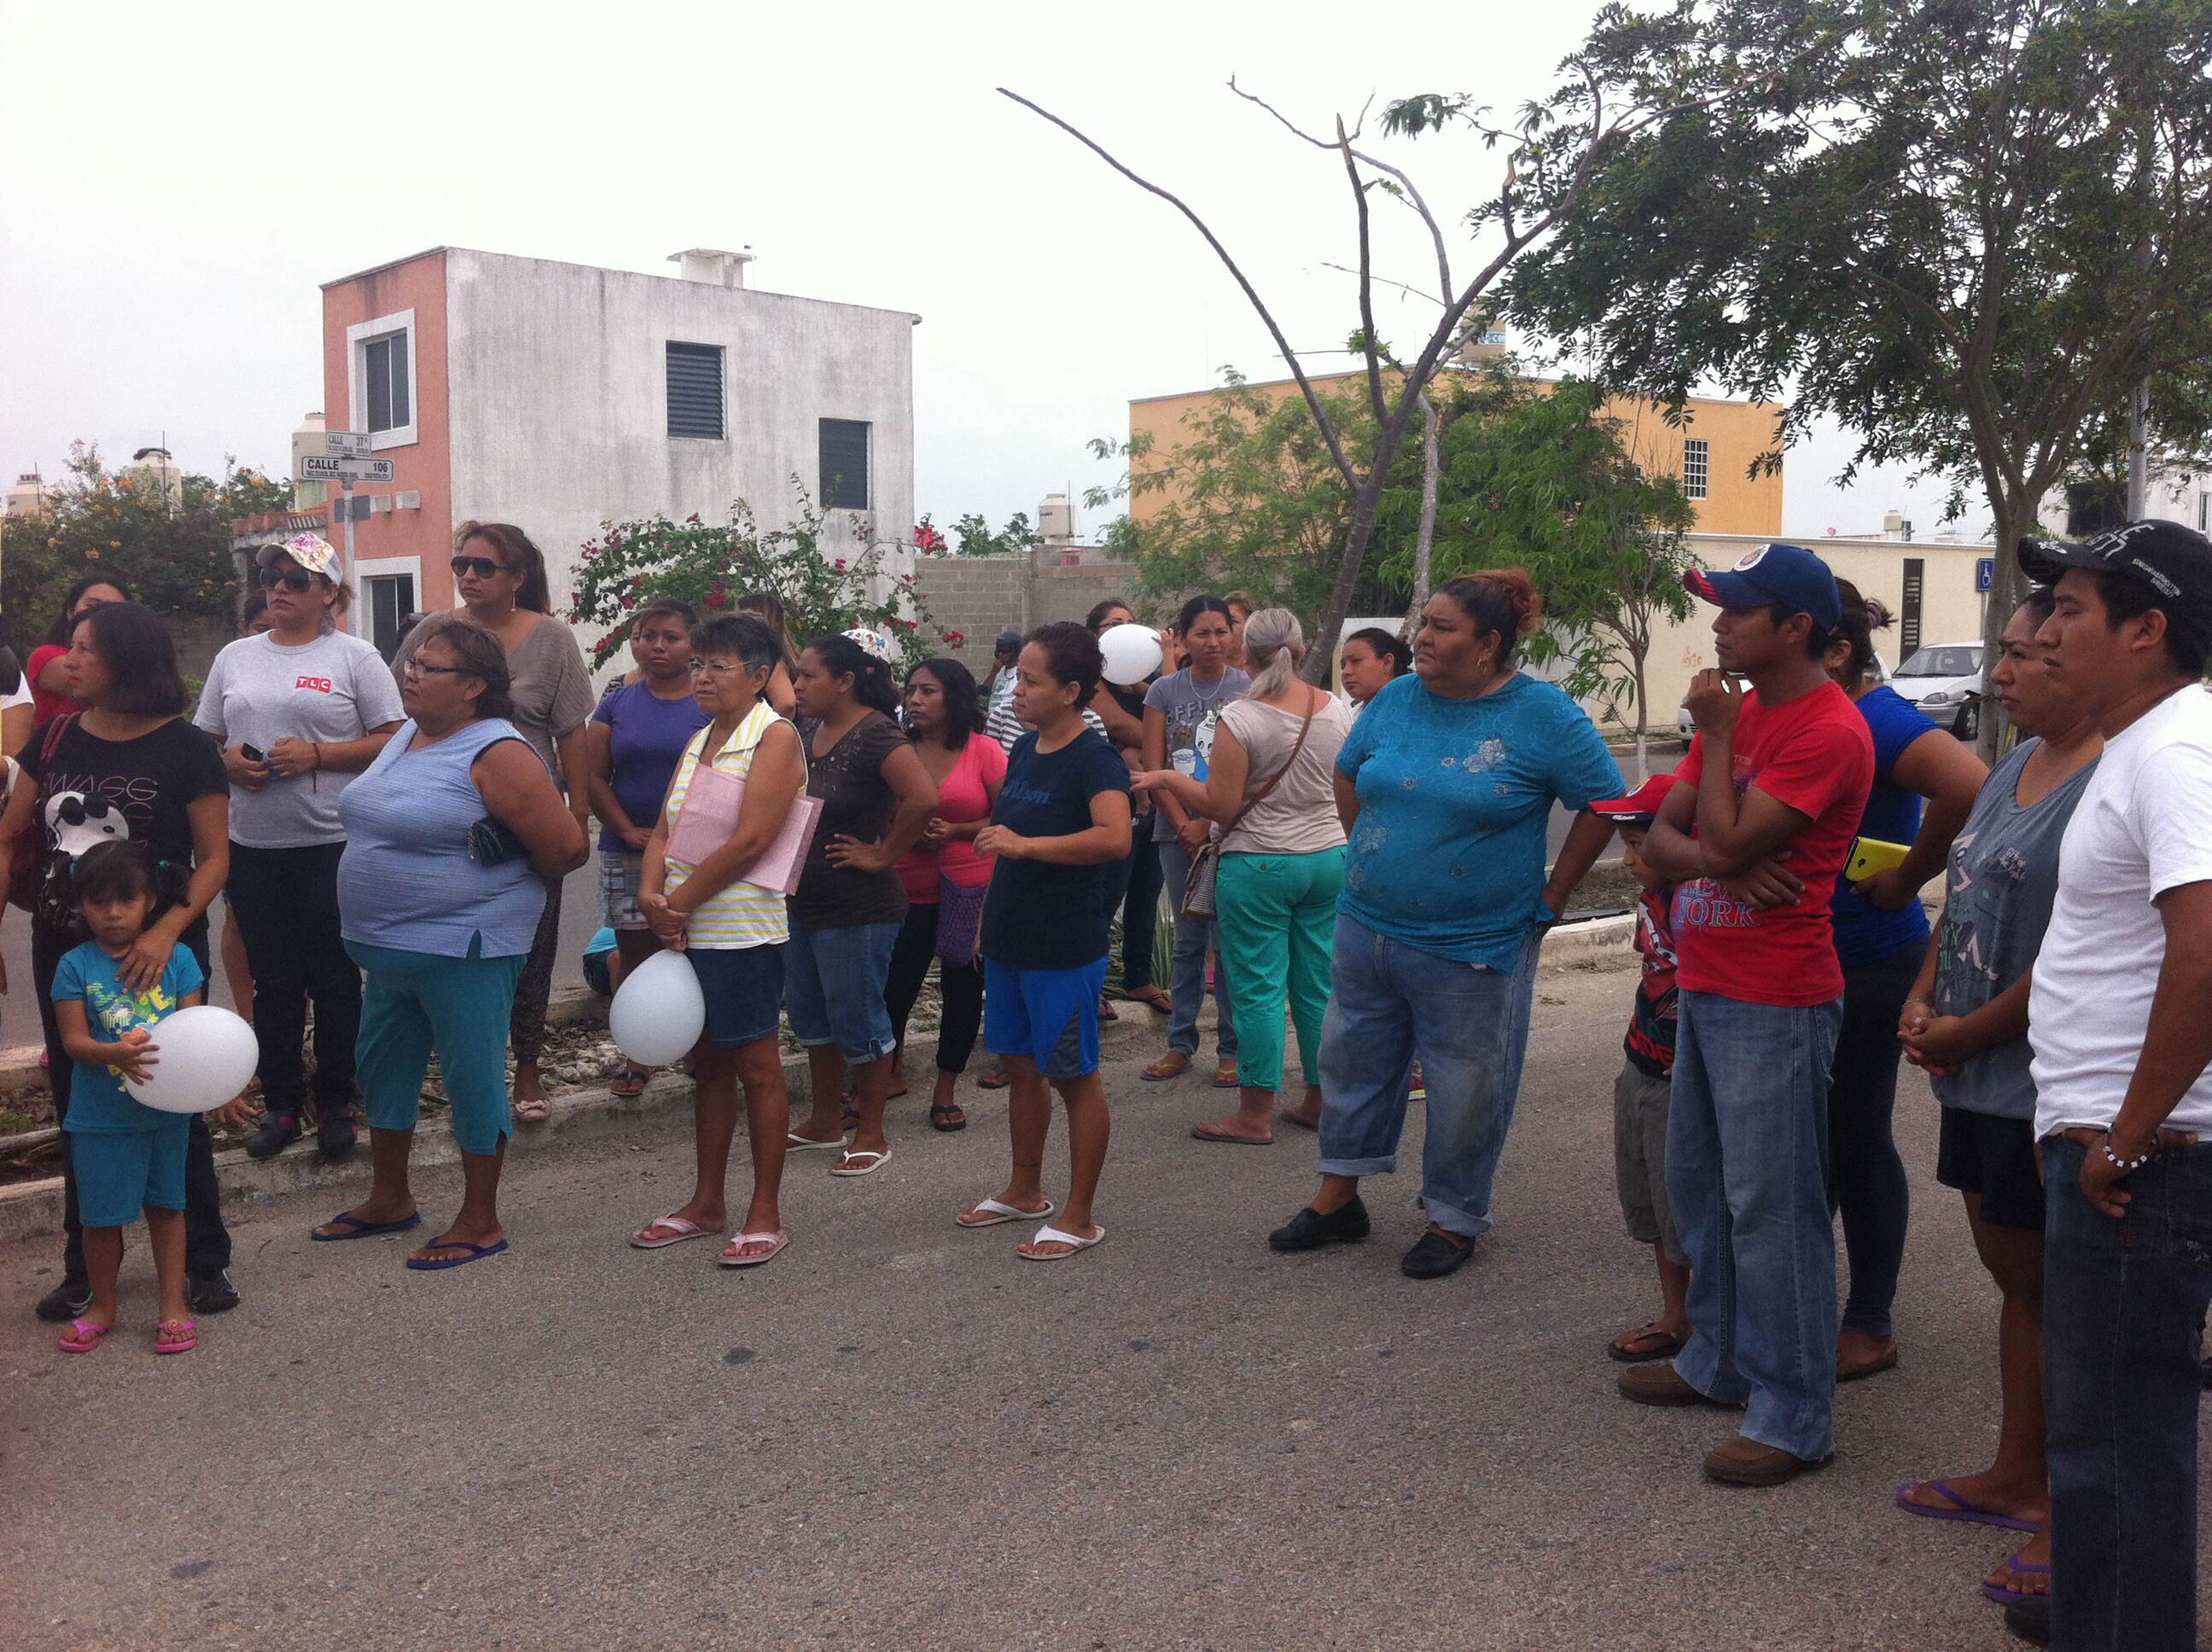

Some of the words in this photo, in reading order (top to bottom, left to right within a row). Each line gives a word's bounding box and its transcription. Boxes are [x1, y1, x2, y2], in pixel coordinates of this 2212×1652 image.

[328, 434, 343, 445] CALLE
[307, 458, 340, 470] CALLE
[373, 462, 388, 473] 106
[298, 677, 330, 690] TLC
[48, 772, 158, 800] WAGG
